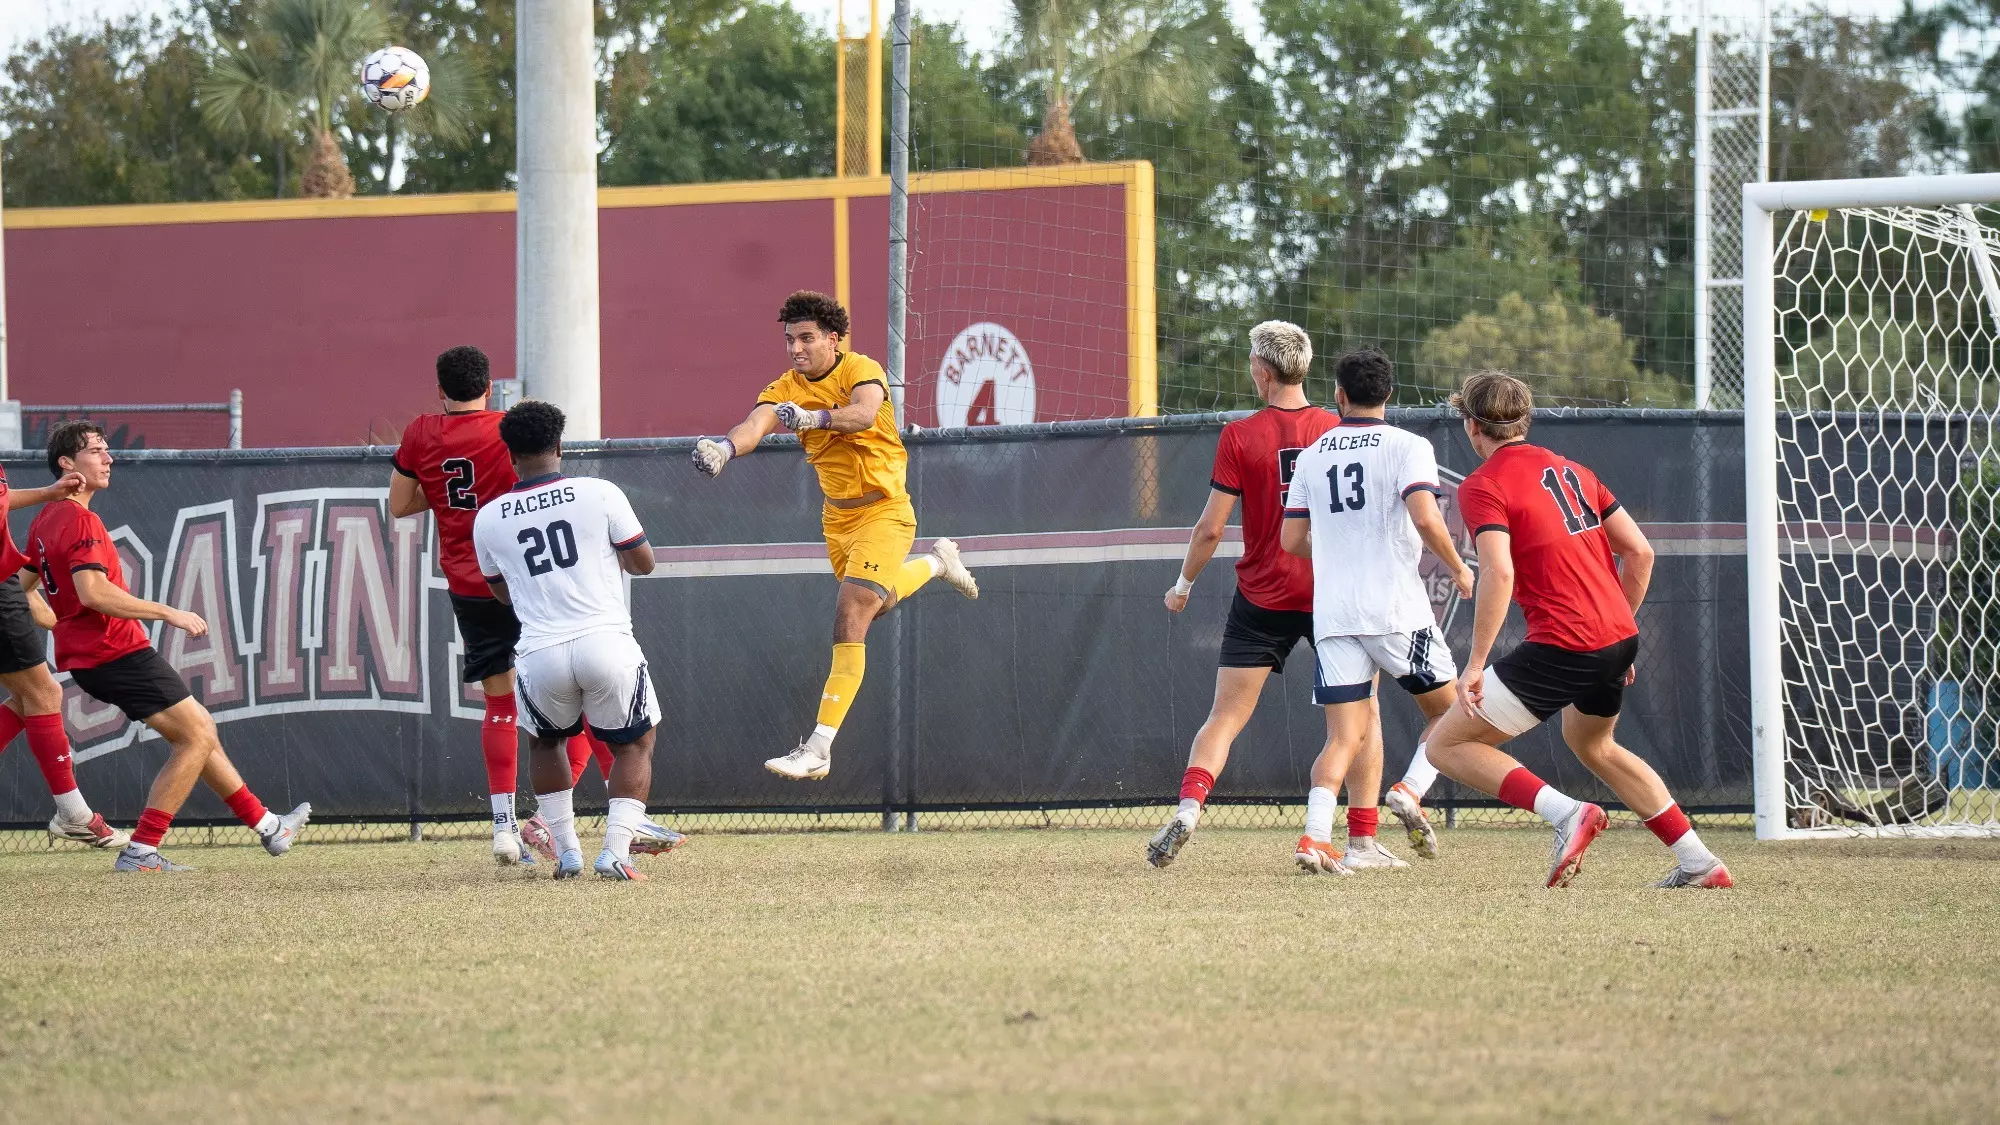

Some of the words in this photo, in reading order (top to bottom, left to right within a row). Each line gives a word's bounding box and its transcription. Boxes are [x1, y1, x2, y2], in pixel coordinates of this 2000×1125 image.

[945, 332, 1028, 385] BARNETT
[966, 379, 1001, 427] 4
[1318, 433, 1382, 454] PACERS
[441, 457, 478, 510] 2
[500, 486, 576, 519] PACERS
[1325, 461, 1366, 514] 13
[1540, 466, 1601, 535] 11
[516, 519, 579, 577] 20
